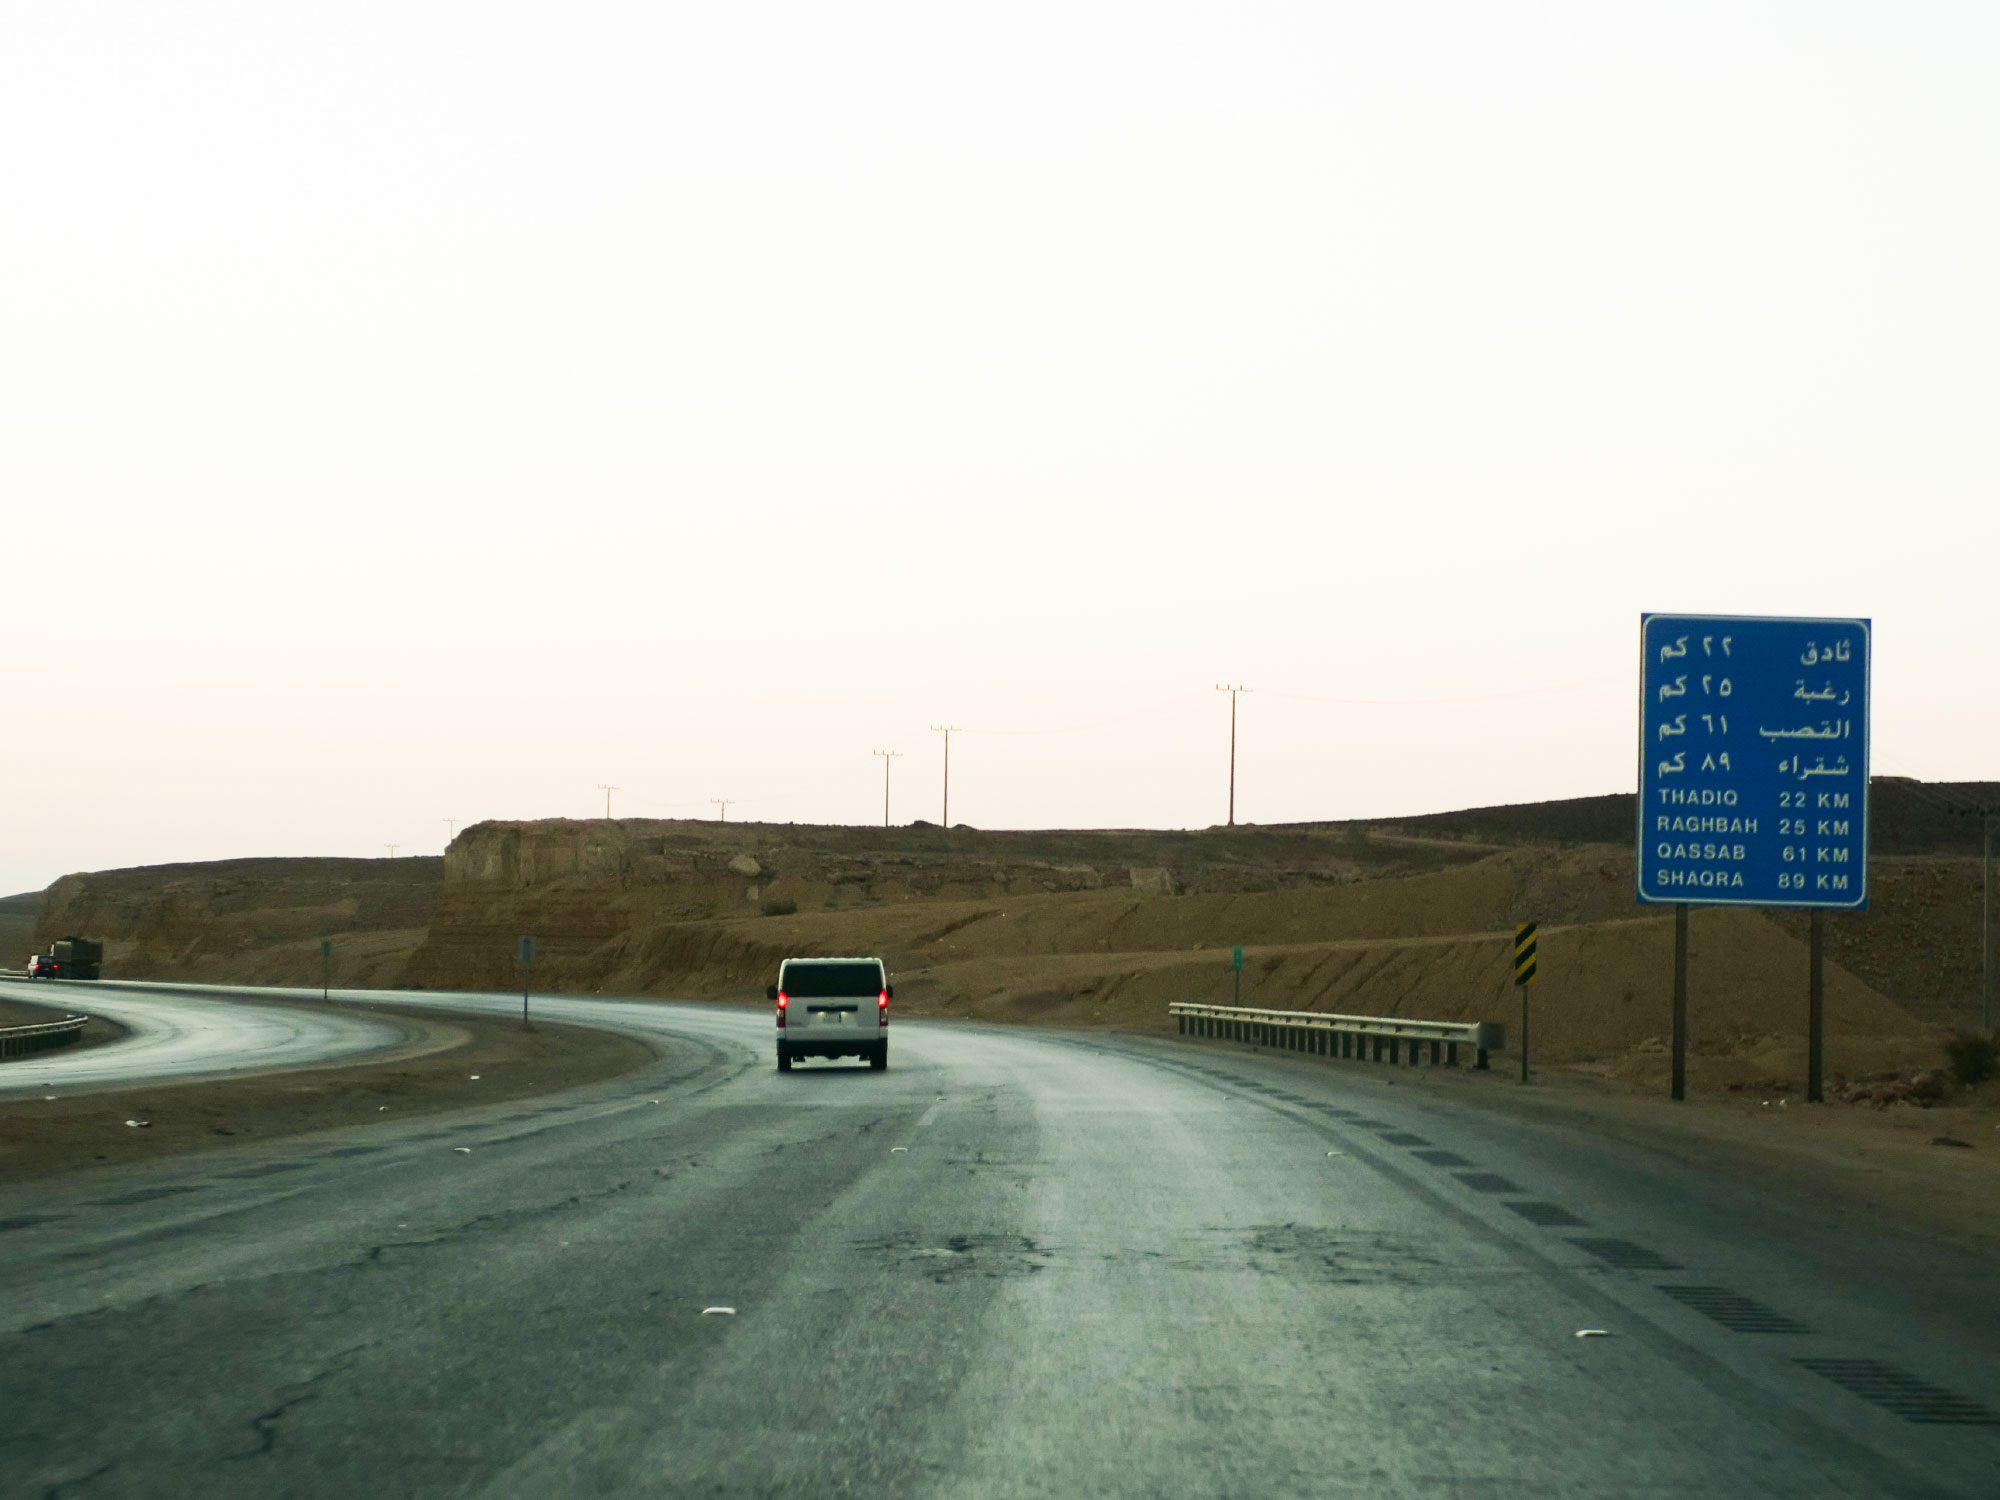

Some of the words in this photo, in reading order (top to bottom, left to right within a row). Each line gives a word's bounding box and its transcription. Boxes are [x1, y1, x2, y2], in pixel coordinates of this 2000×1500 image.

[1661, 636, 1688, 662] كم
[1703, 636, 1731, 656] ٢٢
[1801, 640, 1850, 665] ثادق
[1660, 676, 1686, 702] كم
[1703, 675, 1731, 696] ٢٥
[1795, 680, 1849, 705] رغبة
[1659, 715, 1686, 741] كم
[1702, 715, 1727, 733] ٦١
[1760, 720, 1849, 742] القصب
[1659, 752, 1685, 778] كم
[1702, 752, 1730, 770] ٨٩
[1779, 756, 1848, 780] شقراء
[1659, 789, 1737, 805] THADIQ
[1781, 792, 1805, 807] 22
[1818, 794, 1848, 808] KM
[1658, 816, 1757, 832] RAGHBAH
[1780, 819, 1805, 834] 25
[1818, 821, 1848, 834] KM
[1658, 843, 1745, 859] QASSAB
[1783, 847, 1805, 861] 61
[1818, 848, 1848, 862] KM
[1658, 870, 1743, 886] SHAQRA
[1779, 874, 1804, 888] 89
[1818, 875, 1847, 888] KM
